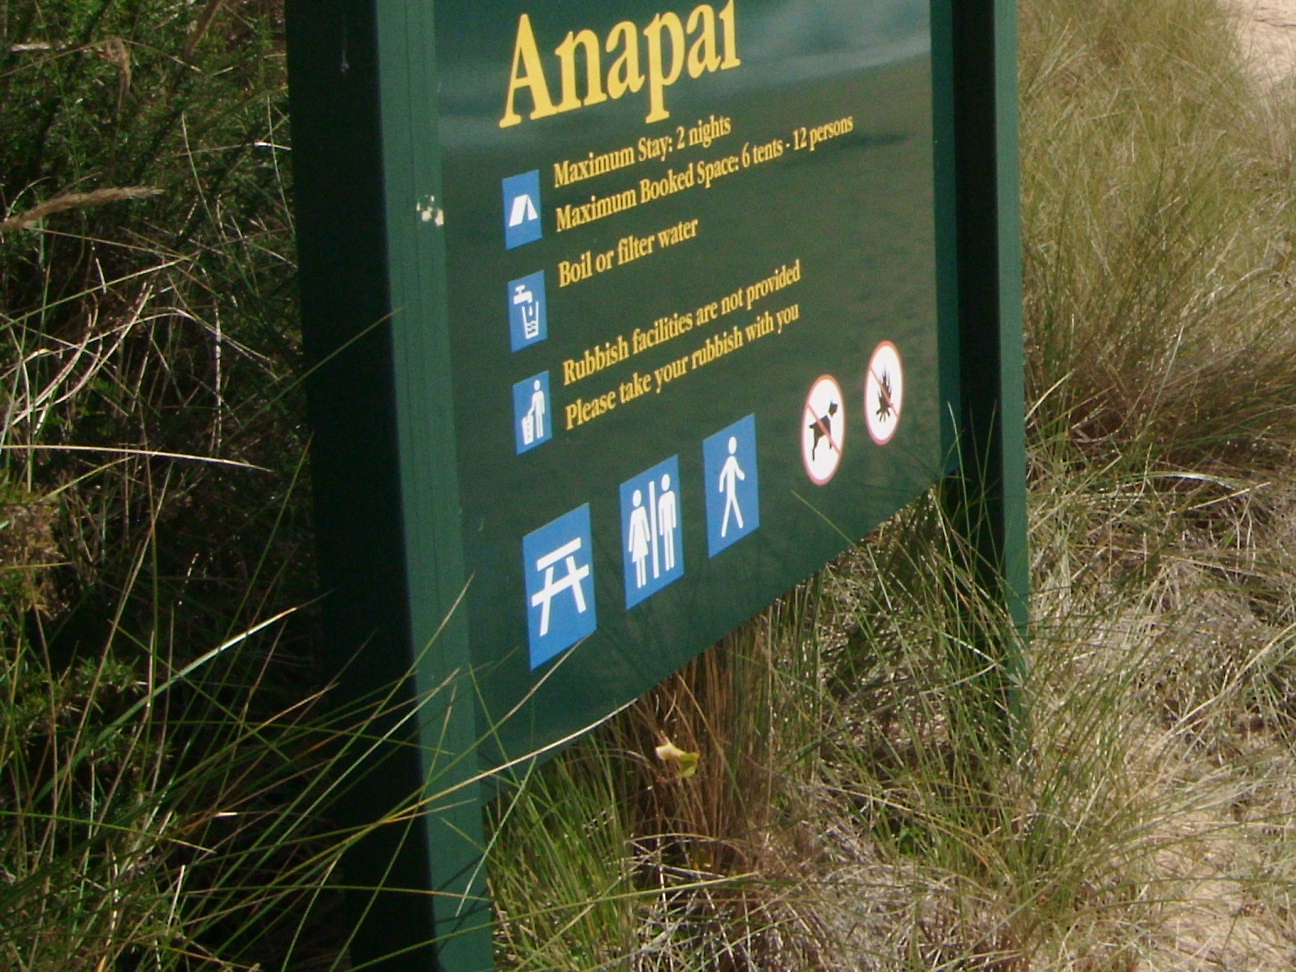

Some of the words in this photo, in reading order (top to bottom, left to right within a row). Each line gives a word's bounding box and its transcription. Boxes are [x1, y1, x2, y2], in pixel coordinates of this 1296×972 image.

[553, 152, 635, 189] Maximum
[638, 138, 672, 163] Stay:
[676, 127, 685, 149] 2
[689, 115, 731, 148] nights
[555, 191, 637, 232] Maximum
[640, 164, 694, 204] Booked
[697, 156, 739, 189] Space:
[741, 143, 750, 166] 6
[753, 139, 783, 164] tents
[793, 128, 807, 150] 12
[809, 115, 853, 152] persons
[559, 253, 592, 288] Boil
[596, 249, 614, 272] or
[617, 233, 655, 266] filter
[658, 218, 698, 247] water
[563, 337, 629, 386] Rubbish
[632, 314, 693, 355] facilities
[696, 303, 718, 325] are
[721, 292, 743, 315] not
[746, 259, 801, 310] provided
[565, 389, 616, 429] Please
[619, 372, 651, 404] take
[654, 358, 688, 392] your
[691, 327, 743, 371] rubbish
[745, 311, 774, 342] with
[776, 304, 799, 333] you
